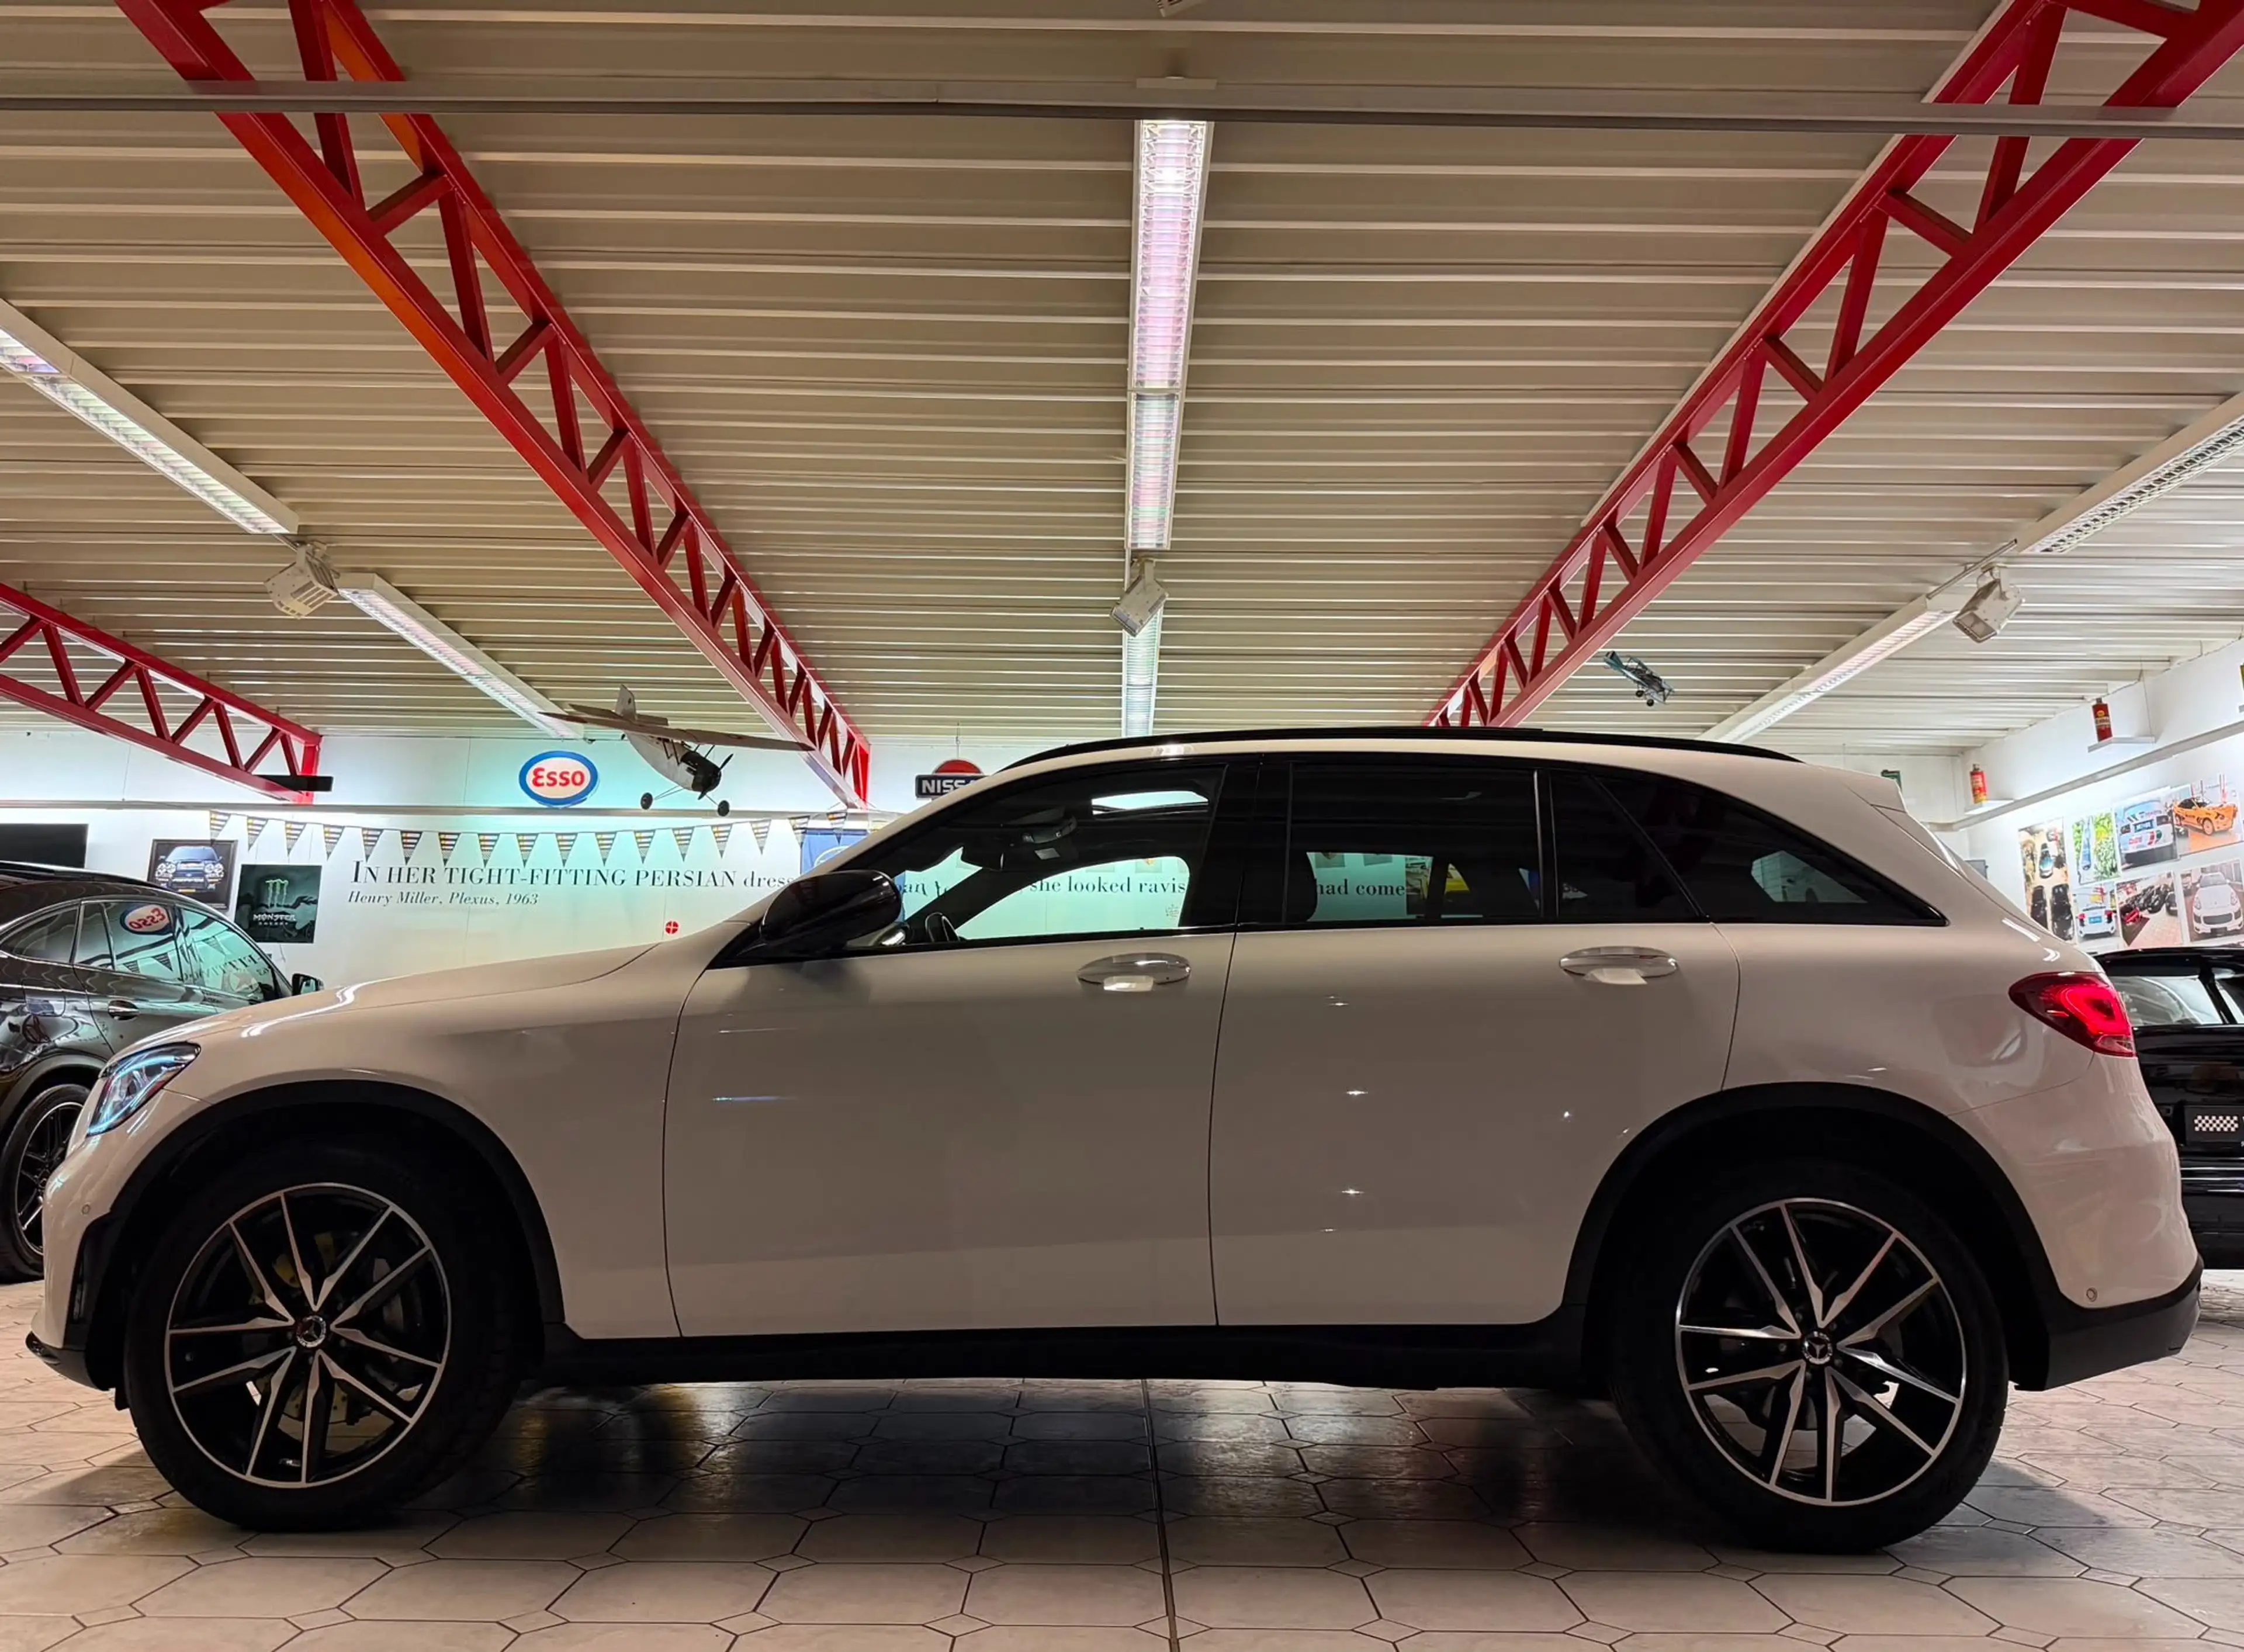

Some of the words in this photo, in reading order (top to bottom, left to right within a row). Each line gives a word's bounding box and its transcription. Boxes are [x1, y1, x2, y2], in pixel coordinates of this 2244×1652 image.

[386, 867, 436, 884] HER
[444, 867, 626, 886] TIGHT-FITTING
[635, 870, 737, 887] PERSIAN
[1030, 879, 1061, 892] she
[1068, 876, 1130, 893] looked
[1356, 884, 1405, 896] come
[348, 891, 393, 907] Henry
[505, 893, 539, 905] 1963
